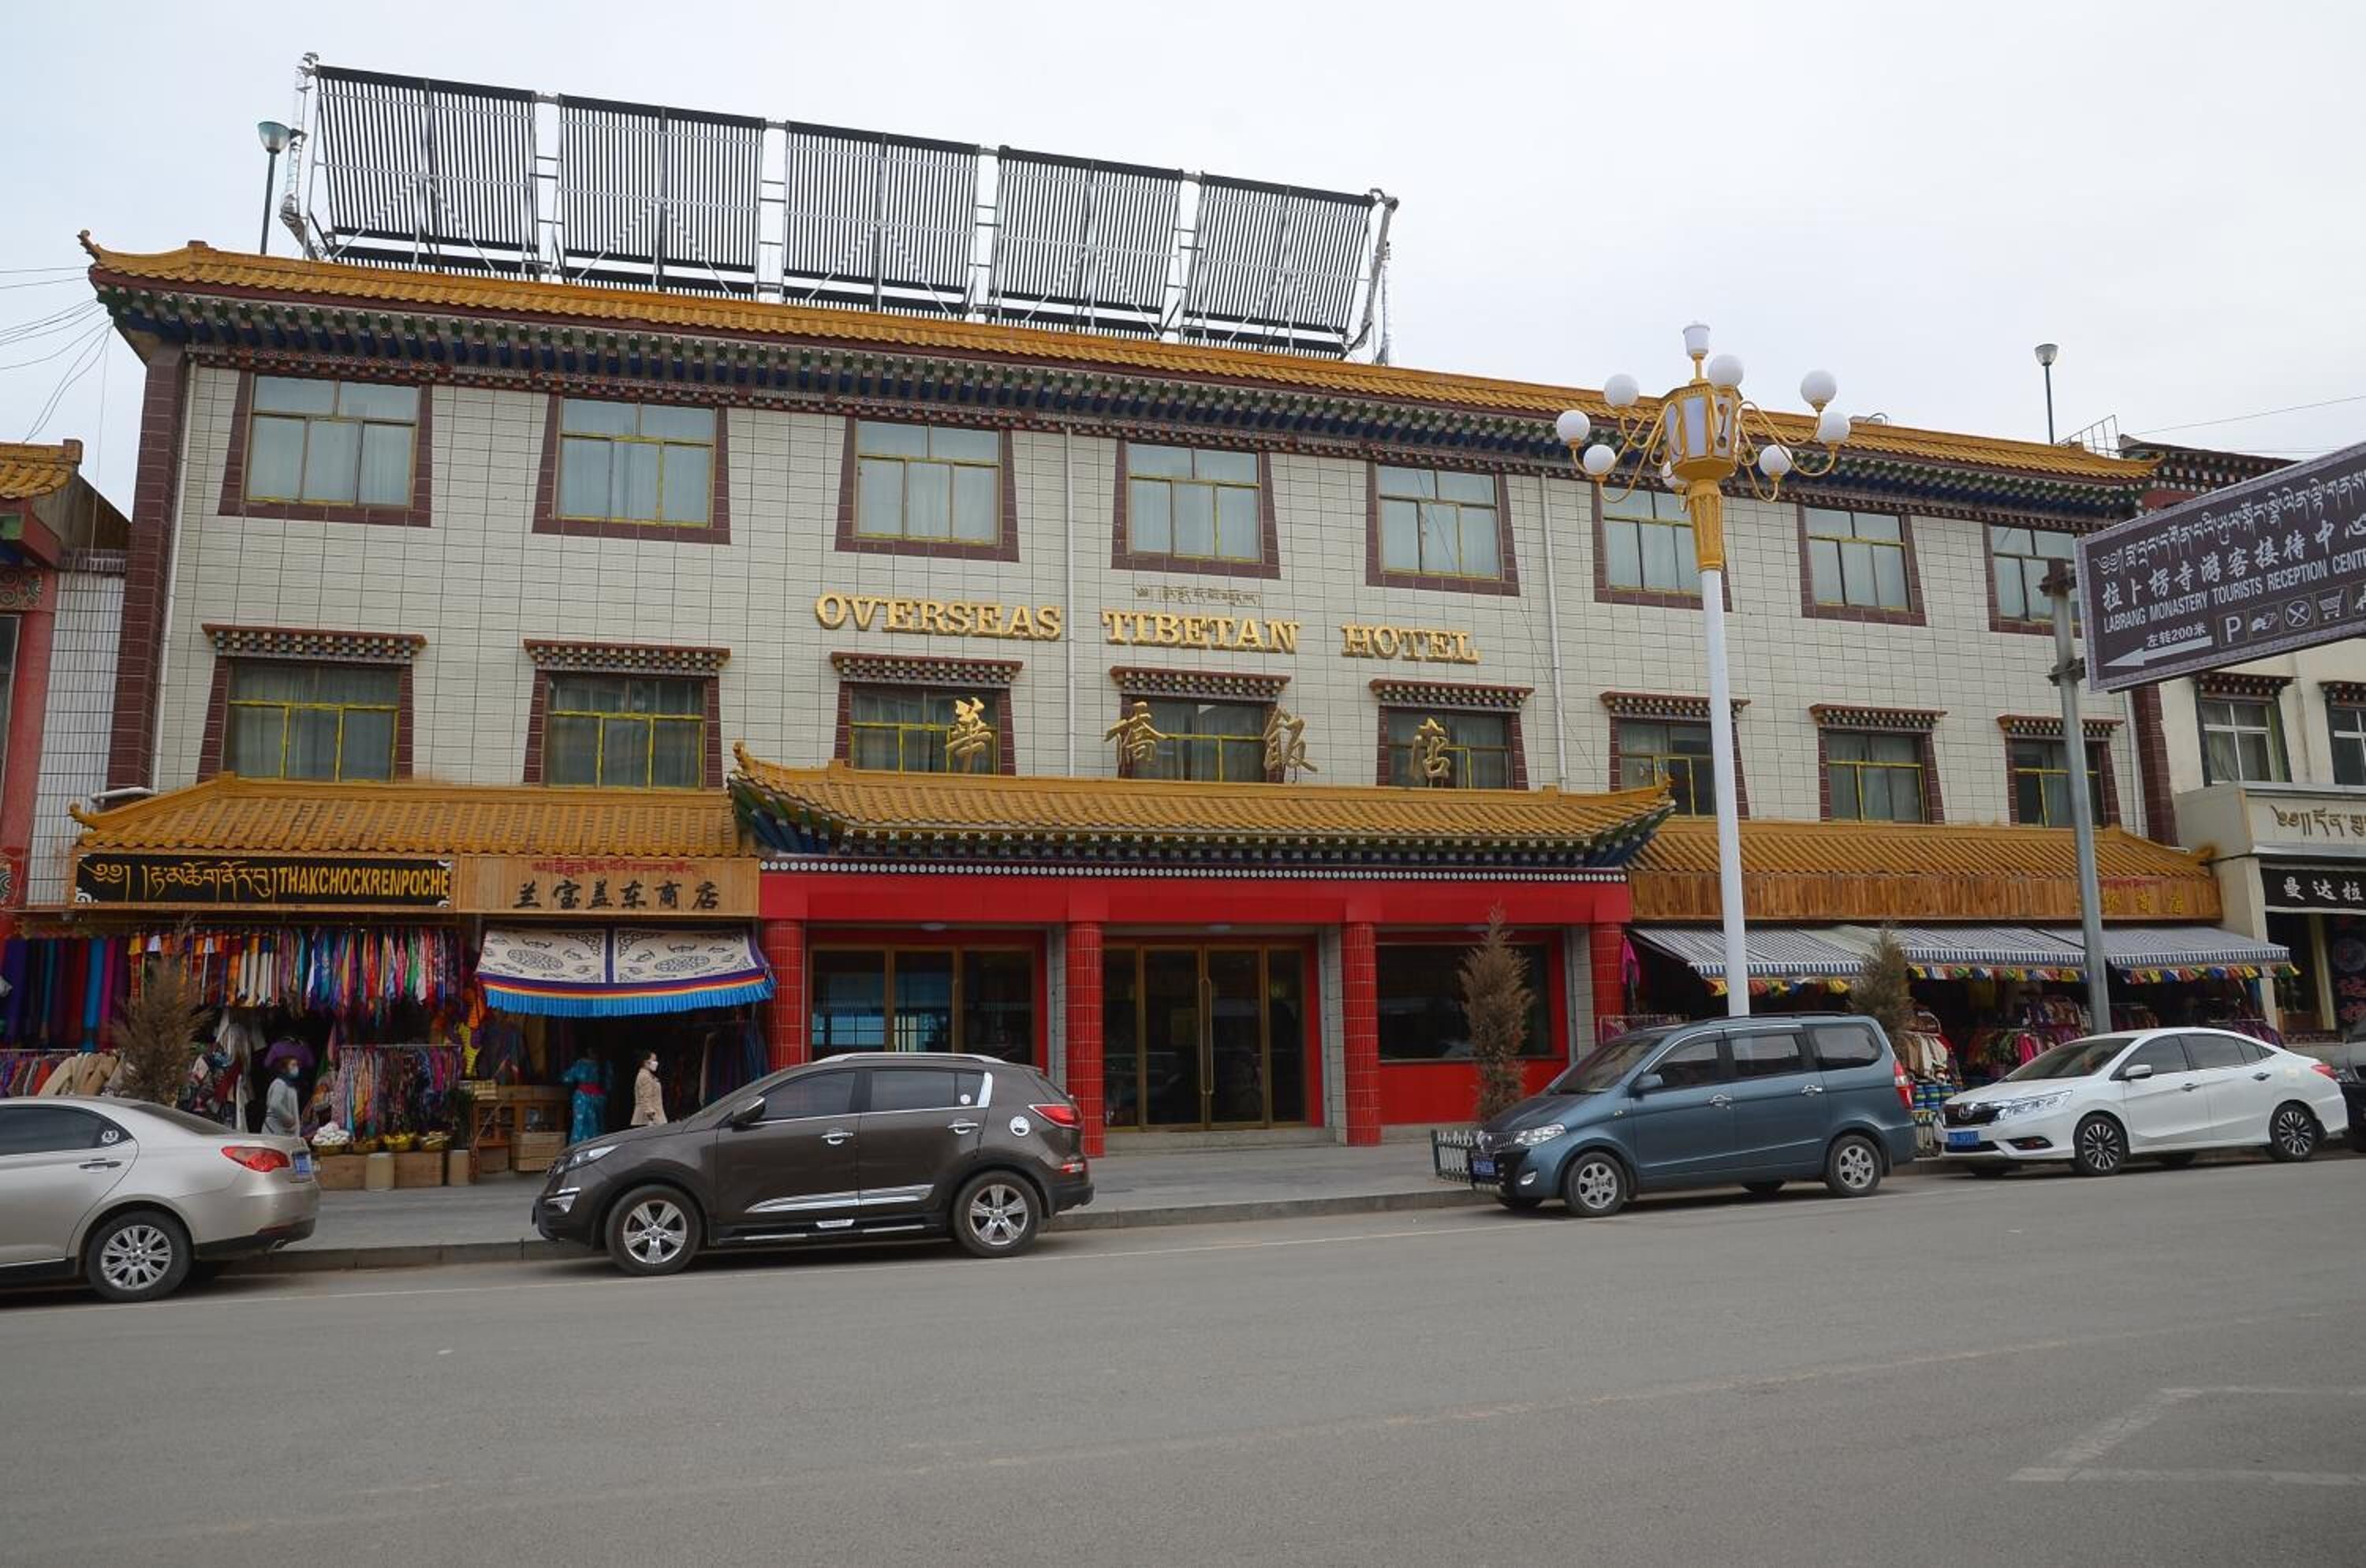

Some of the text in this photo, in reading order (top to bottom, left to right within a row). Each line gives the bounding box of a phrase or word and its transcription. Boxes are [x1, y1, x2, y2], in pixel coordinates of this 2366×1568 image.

[2103, 608, 2146, 633] LABRANG
[2150, 591, 2208, 622] MONASTERY
[2211, 577, 2263, 606] TOURISTS
[2267, 558, 2329, 593] RECEPTION
[815, 592, 1480, 664] OVERSEAS TIBETAN HOTEL
[2146, 622, 2207, 648] 左转200米
[278, 865, 449, 896] THAKCHOCKRENPOCHE
[2283, 875, 2364, 905] 曼达拉
